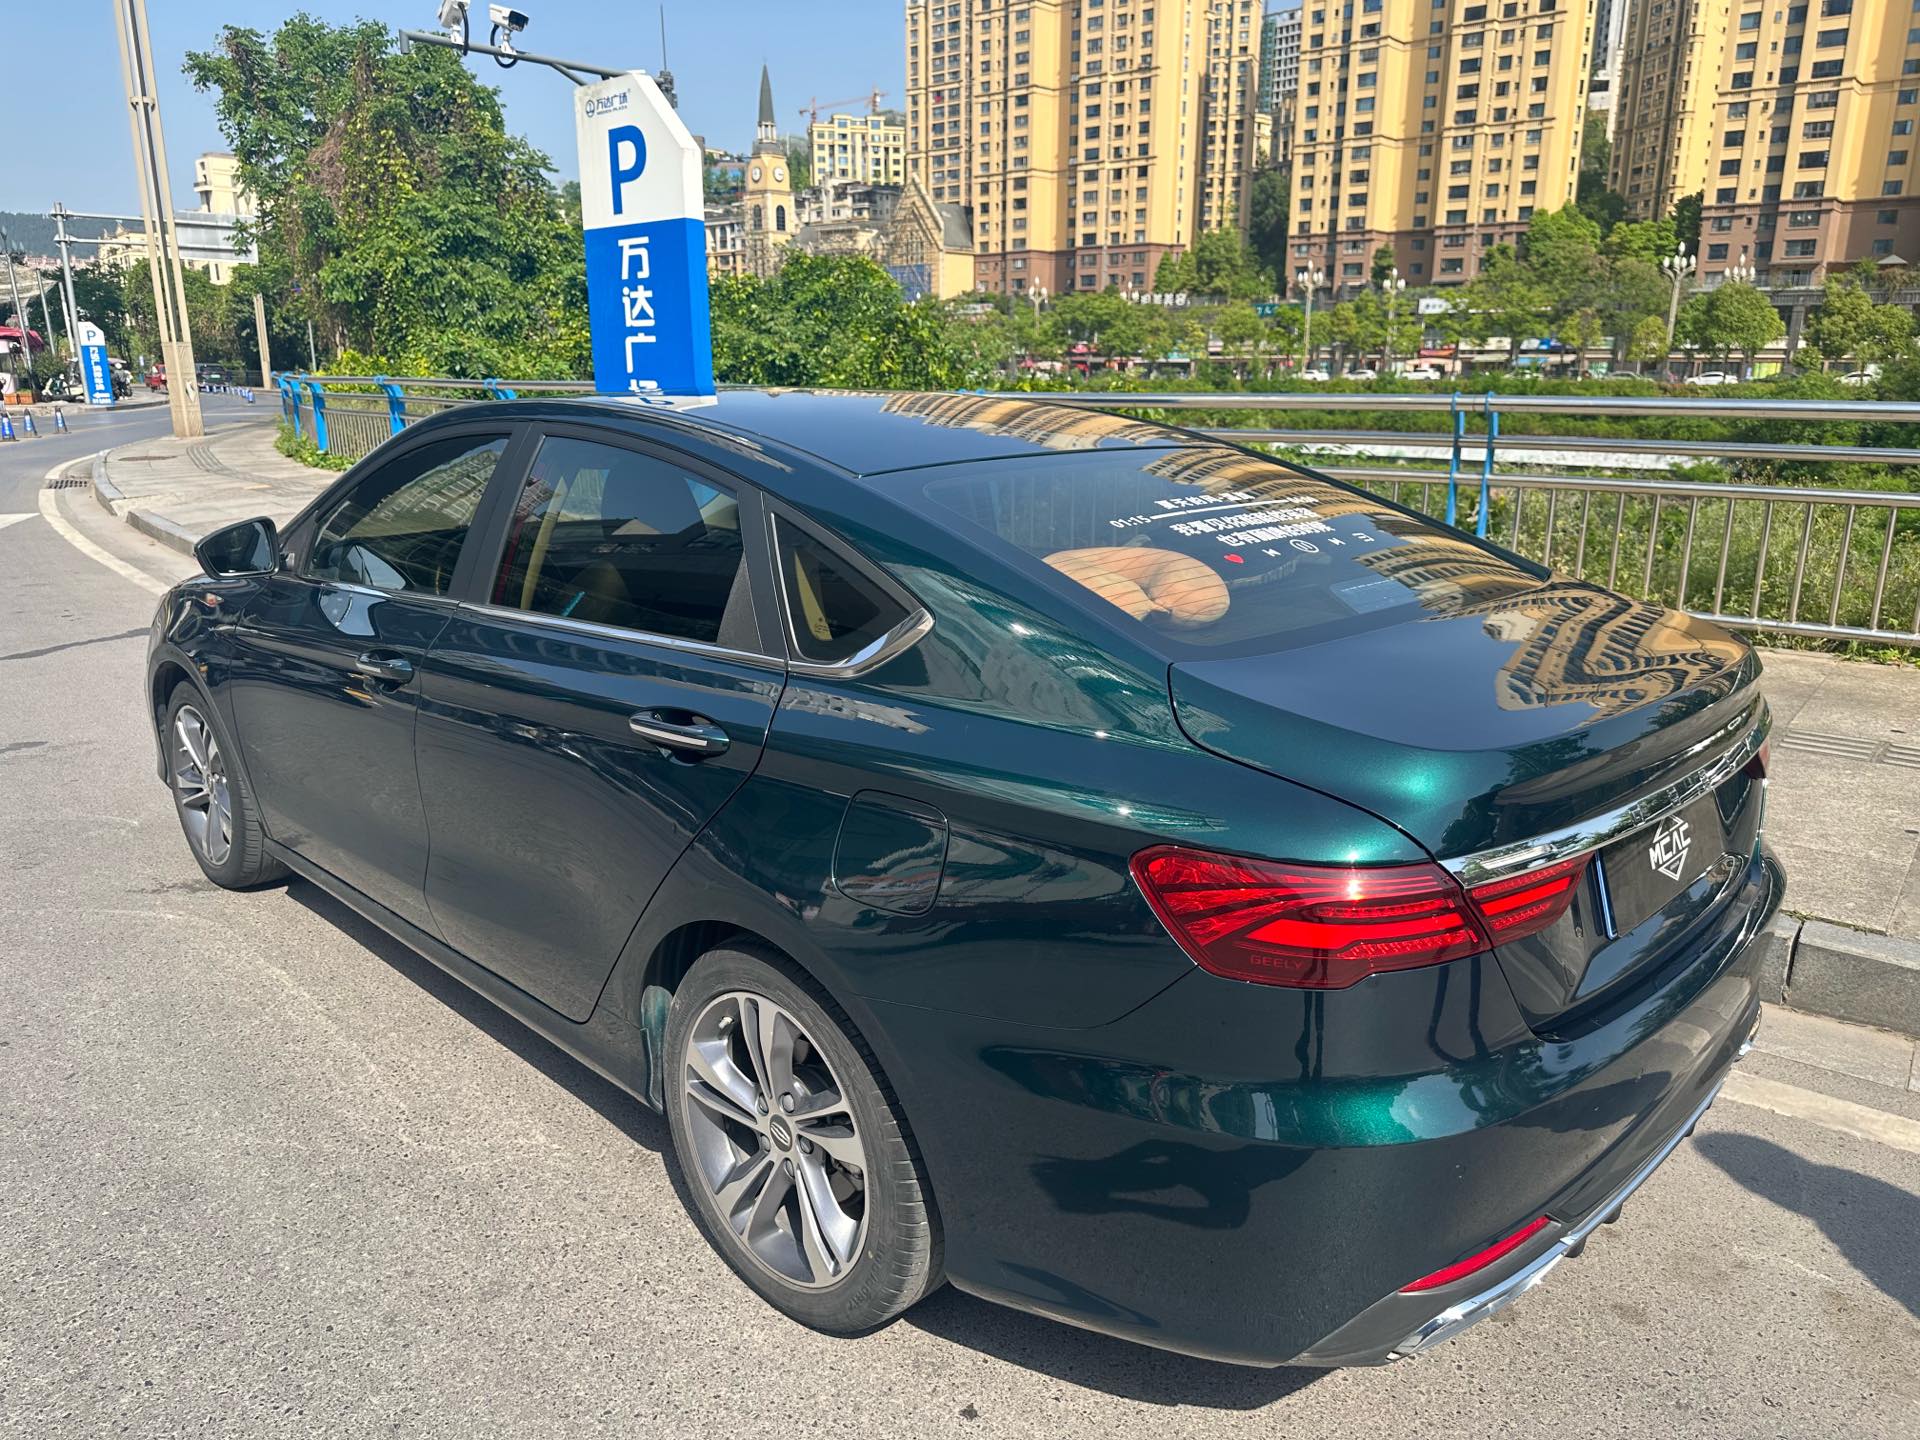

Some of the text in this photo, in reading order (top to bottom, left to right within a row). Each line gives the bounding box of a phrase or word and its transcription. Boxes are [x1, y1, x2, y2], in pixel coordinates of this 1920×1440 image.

[608, 125, 647, 216] P
[86, 330, 97, 341] P
[1109, 515, 1152, 529] 01:15
[1250, 954, 1304, 969] GEELY
